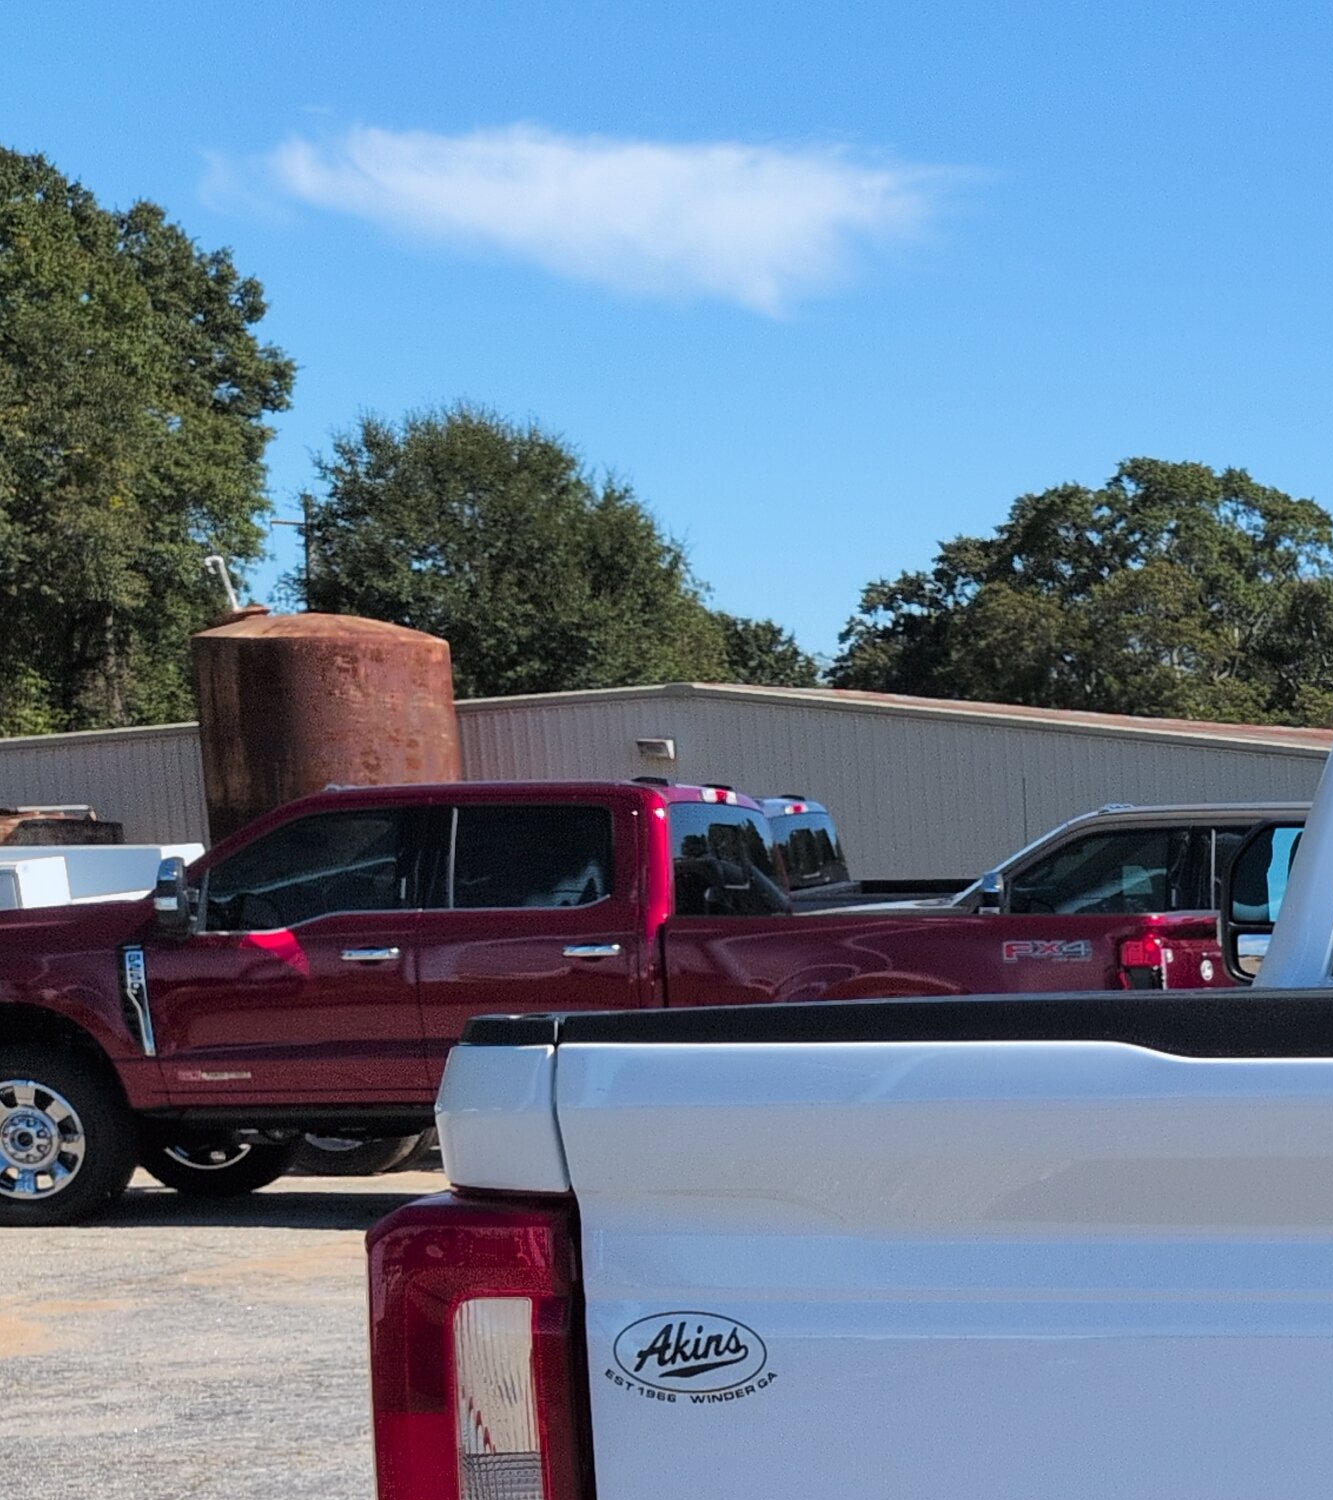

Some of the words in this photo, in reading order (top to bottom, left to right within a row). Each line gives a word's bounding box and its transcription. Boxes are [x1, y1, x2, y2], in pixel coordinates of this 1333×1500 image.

[1002, 940, 1093, 964] FX4
[633, 1321, 749, 1378] Akins
[604, 1368, 635, 1391] EST
[637, 1386, 678, 1404] 1966
[689, 1384, 757, 1404] WINDER
[757, 1371, 778, 1390] GA
